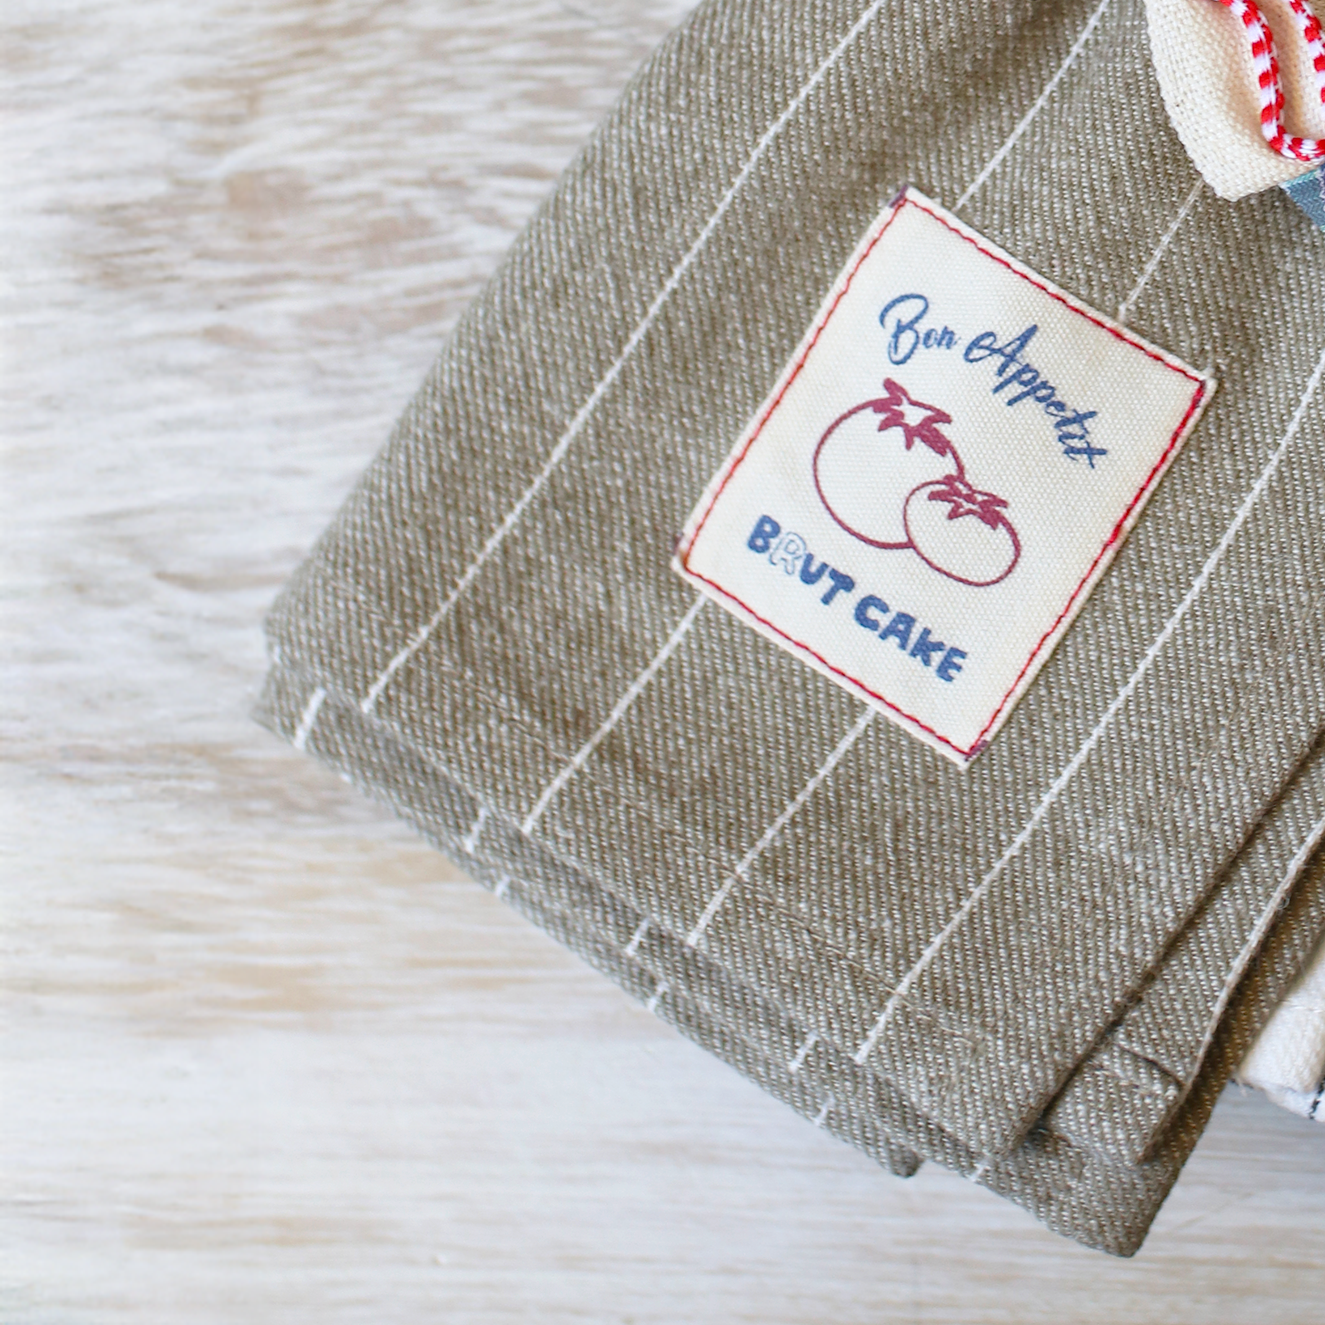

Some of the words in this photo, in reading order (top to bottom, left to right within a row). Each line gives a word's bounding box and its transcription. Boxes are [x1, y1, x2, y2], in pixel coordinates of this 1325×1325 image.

[879, 293, 960, 365] Bon
[964, 324, 1107, 469] Appetit
[748, 515, 855, 606] BRUT
[854, 594, 968, 682] CAKE
